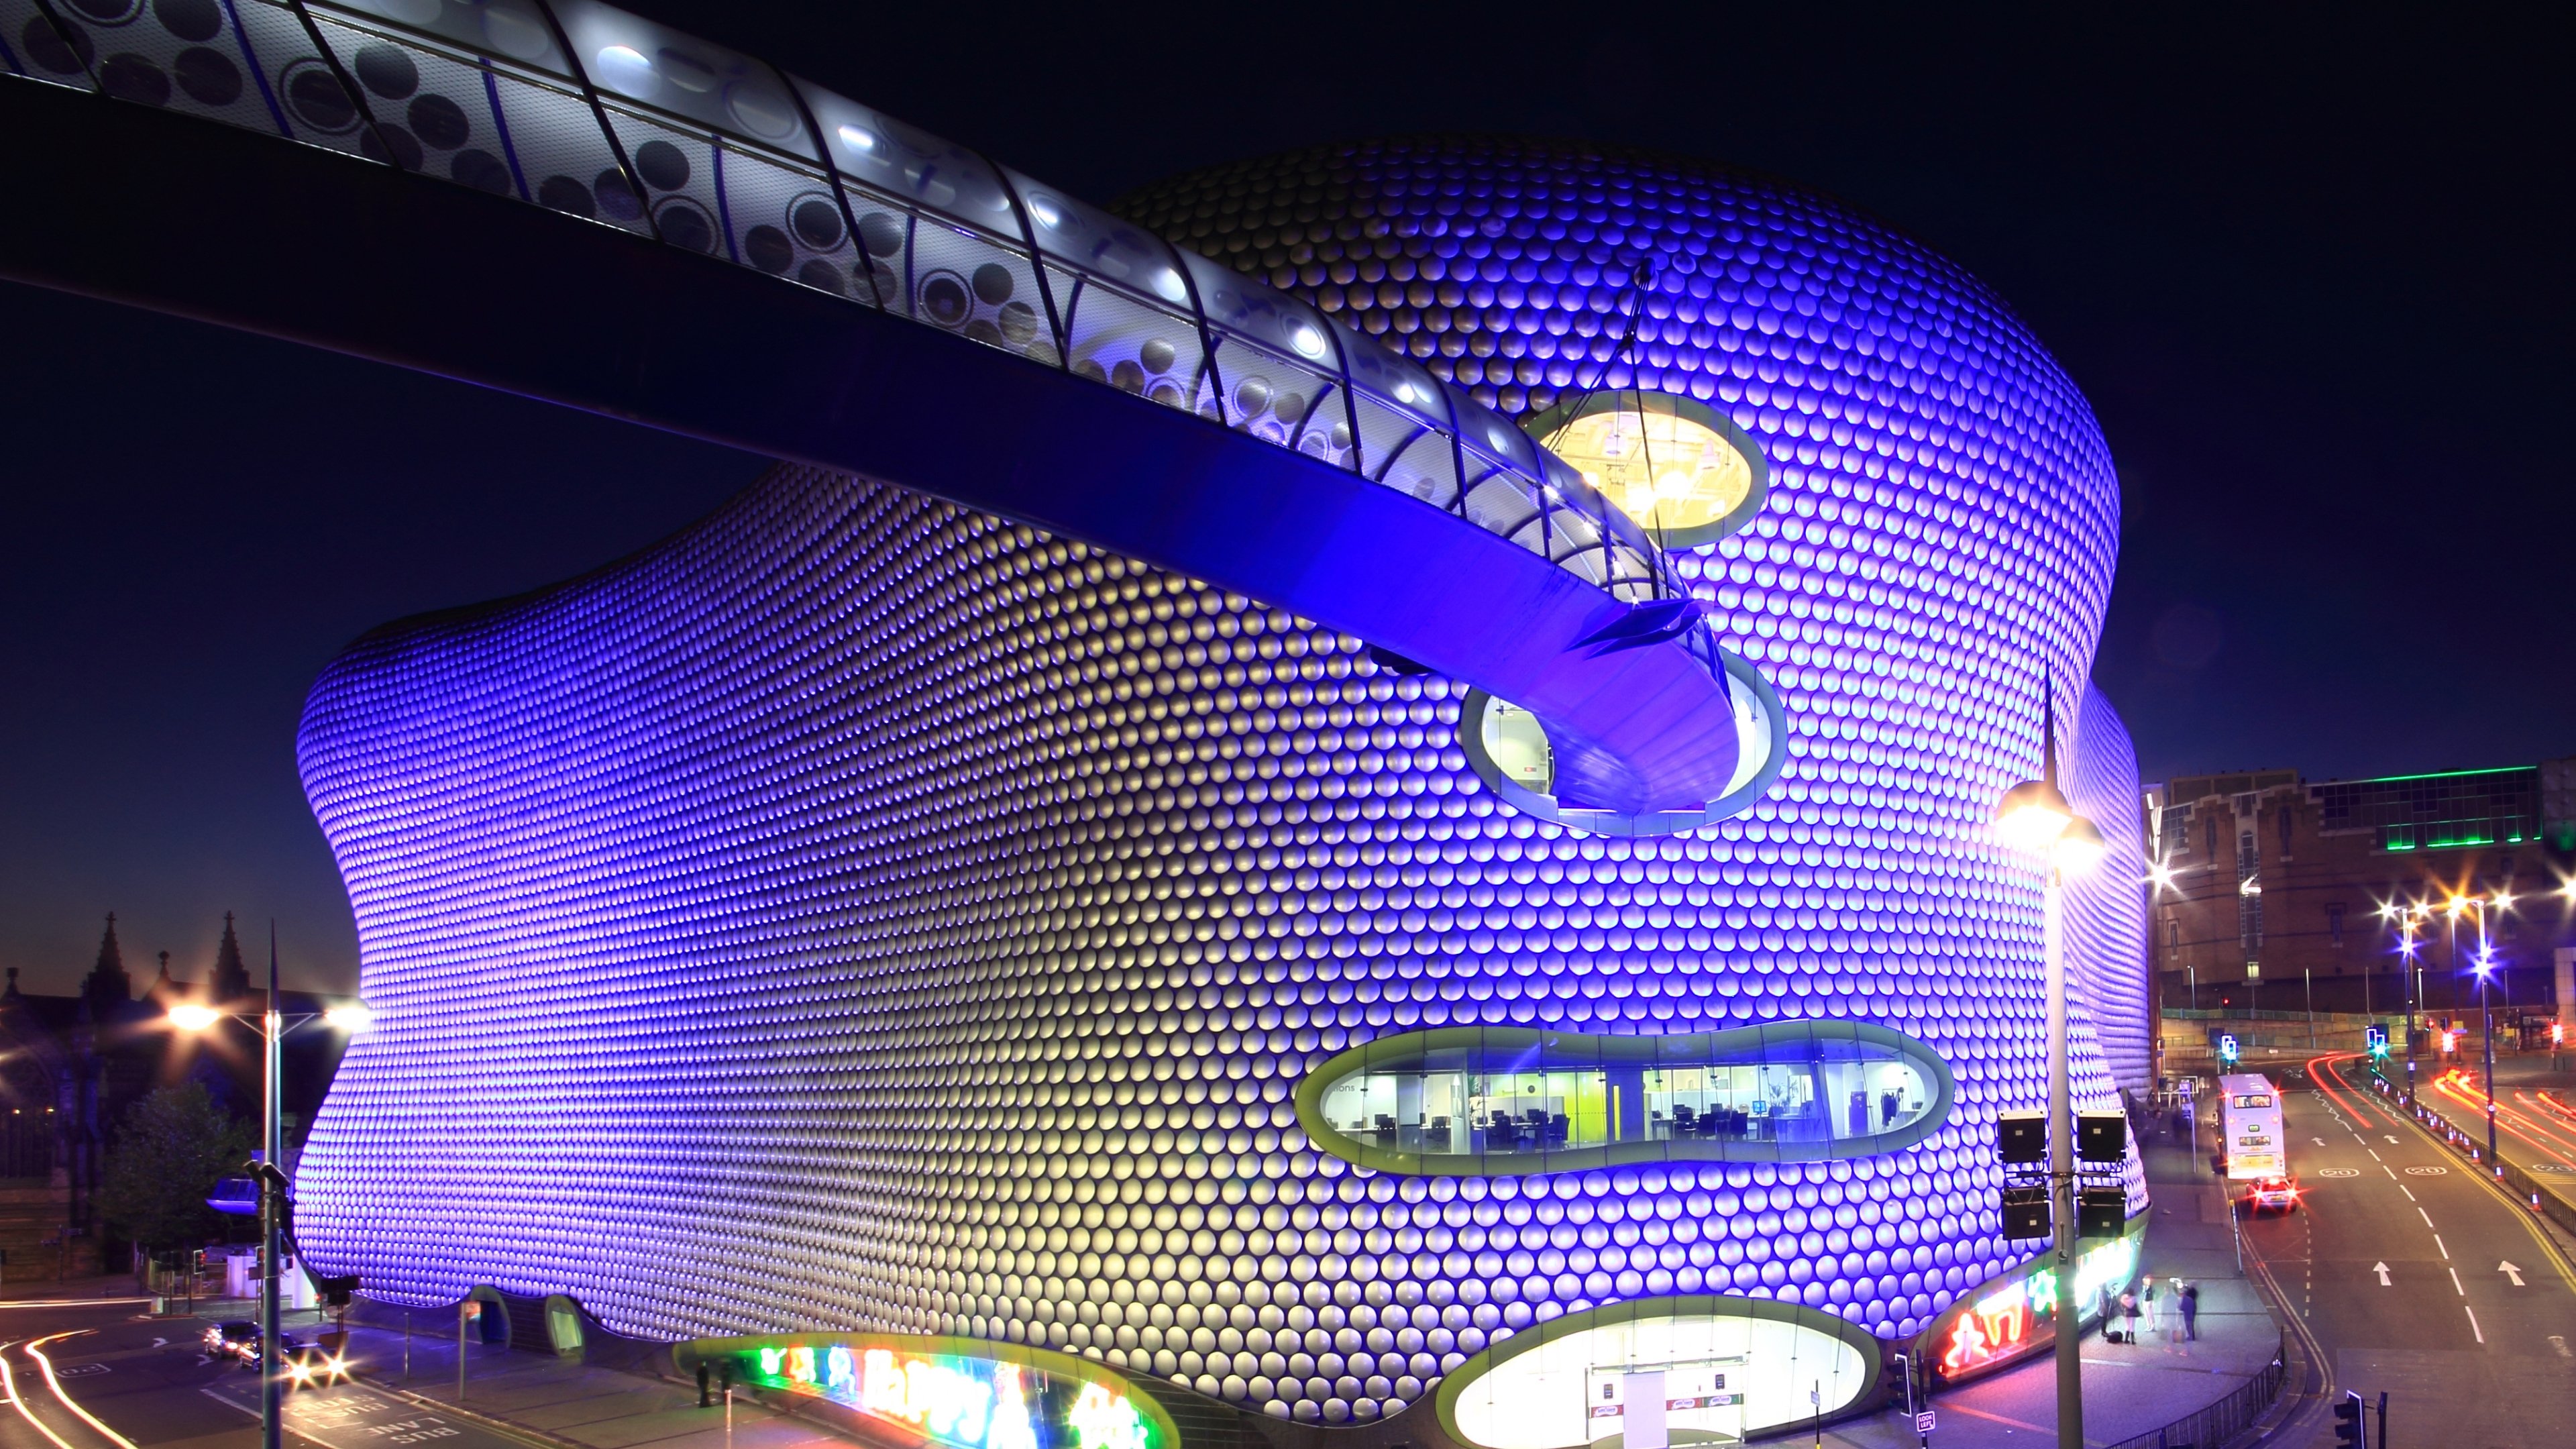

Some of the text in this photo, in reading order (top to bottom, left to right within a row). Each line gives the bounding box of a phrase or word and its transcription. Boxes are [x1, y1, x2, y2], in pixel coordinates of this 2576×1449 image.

[325, 1402, 390, 1417] BUS
[366, 1417, 445, 1437] LANE
[1920, 1420, 1932, 1428] LEFT
[390, 1427, 461, 1444] BUS
